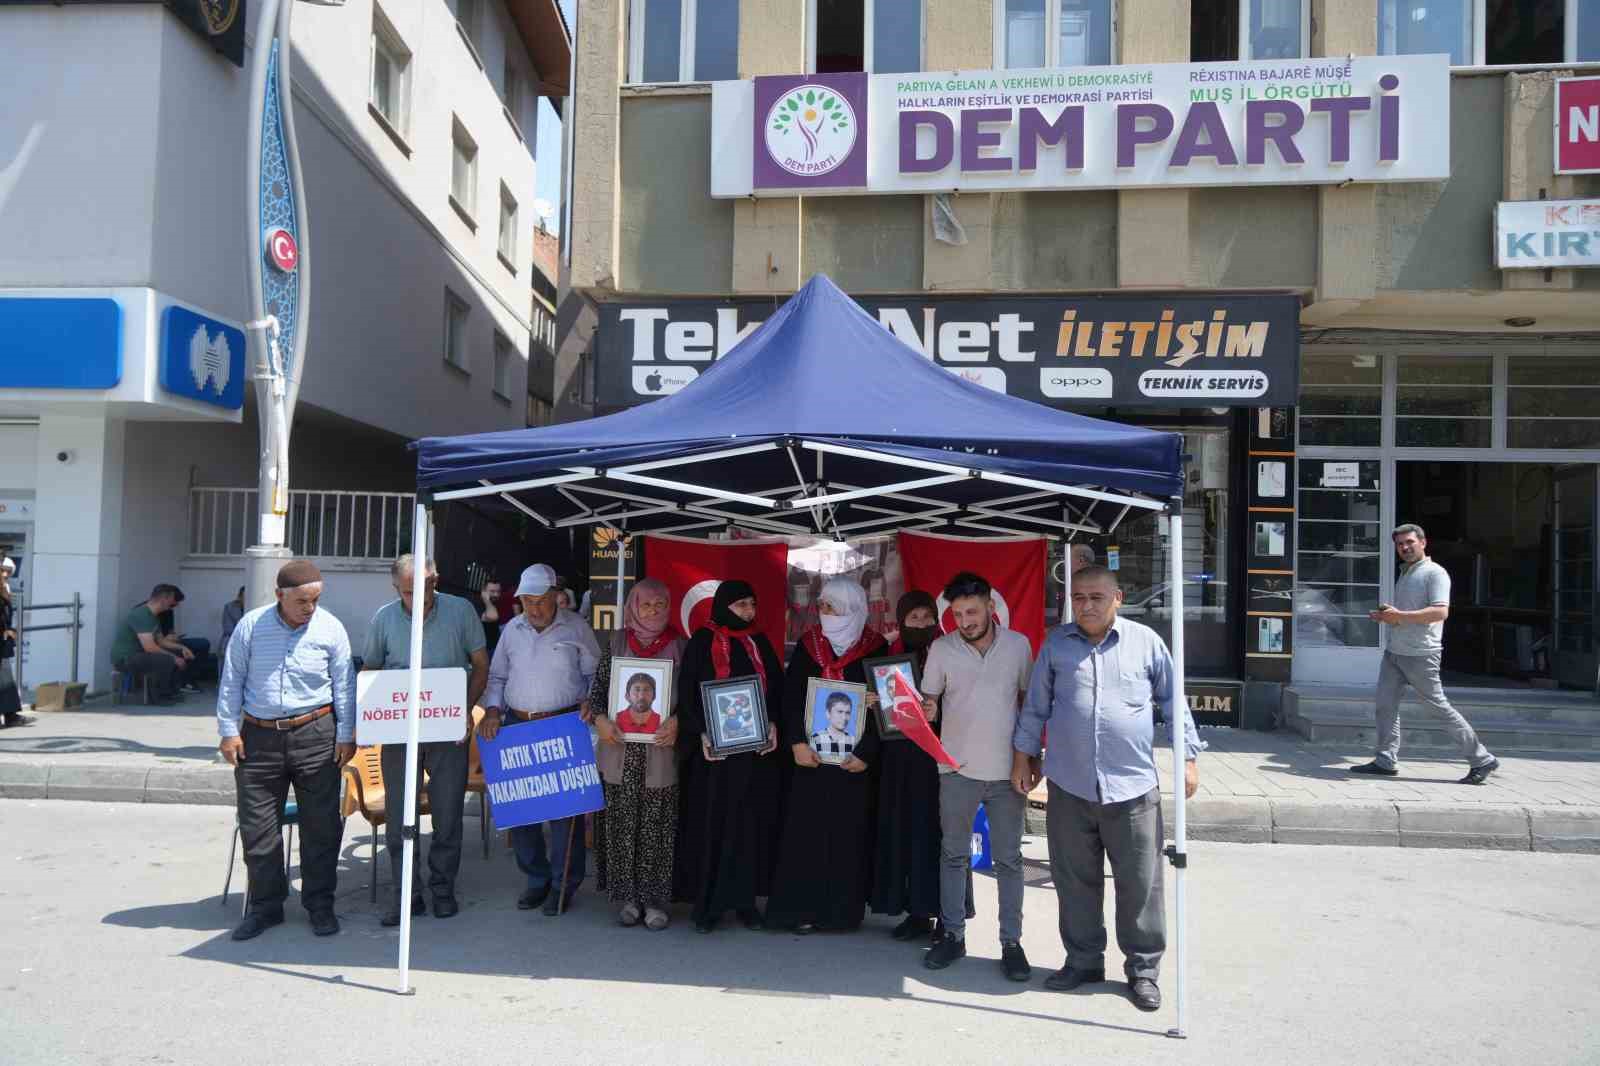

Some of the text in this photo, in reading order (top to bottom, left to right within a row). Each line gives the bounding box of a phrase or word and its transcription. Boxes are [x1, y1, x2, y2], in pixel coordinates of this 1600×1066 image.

[946, 79, 985, 91] GELAN
[990, 79, 998, 90] A
[1190, 80, 1352, 104] MUŞ İL ÖRGÜTÜ
[898, 88, 1152, 108] HALKLARIN EŞİTLİK VE DEMOKRASİ PARTİSİ
[899, 74, 1399, 175] DEM PARTİ
[785, 157, 805, 171] DEM
[1055, 309, 1269, 367] İLETİŞİM
[1144, 374, 1264, 391] TEKNİK SERVİS
[392, 690, 433, 703] EVAT
[363, 704, 461, 720] NÖBETDEYİZ
[500, 744, 533, 770] ARTIK
[532, 737, 567, 764] YETER
[487, 772, 560, 805] YAKAMIZDAN
